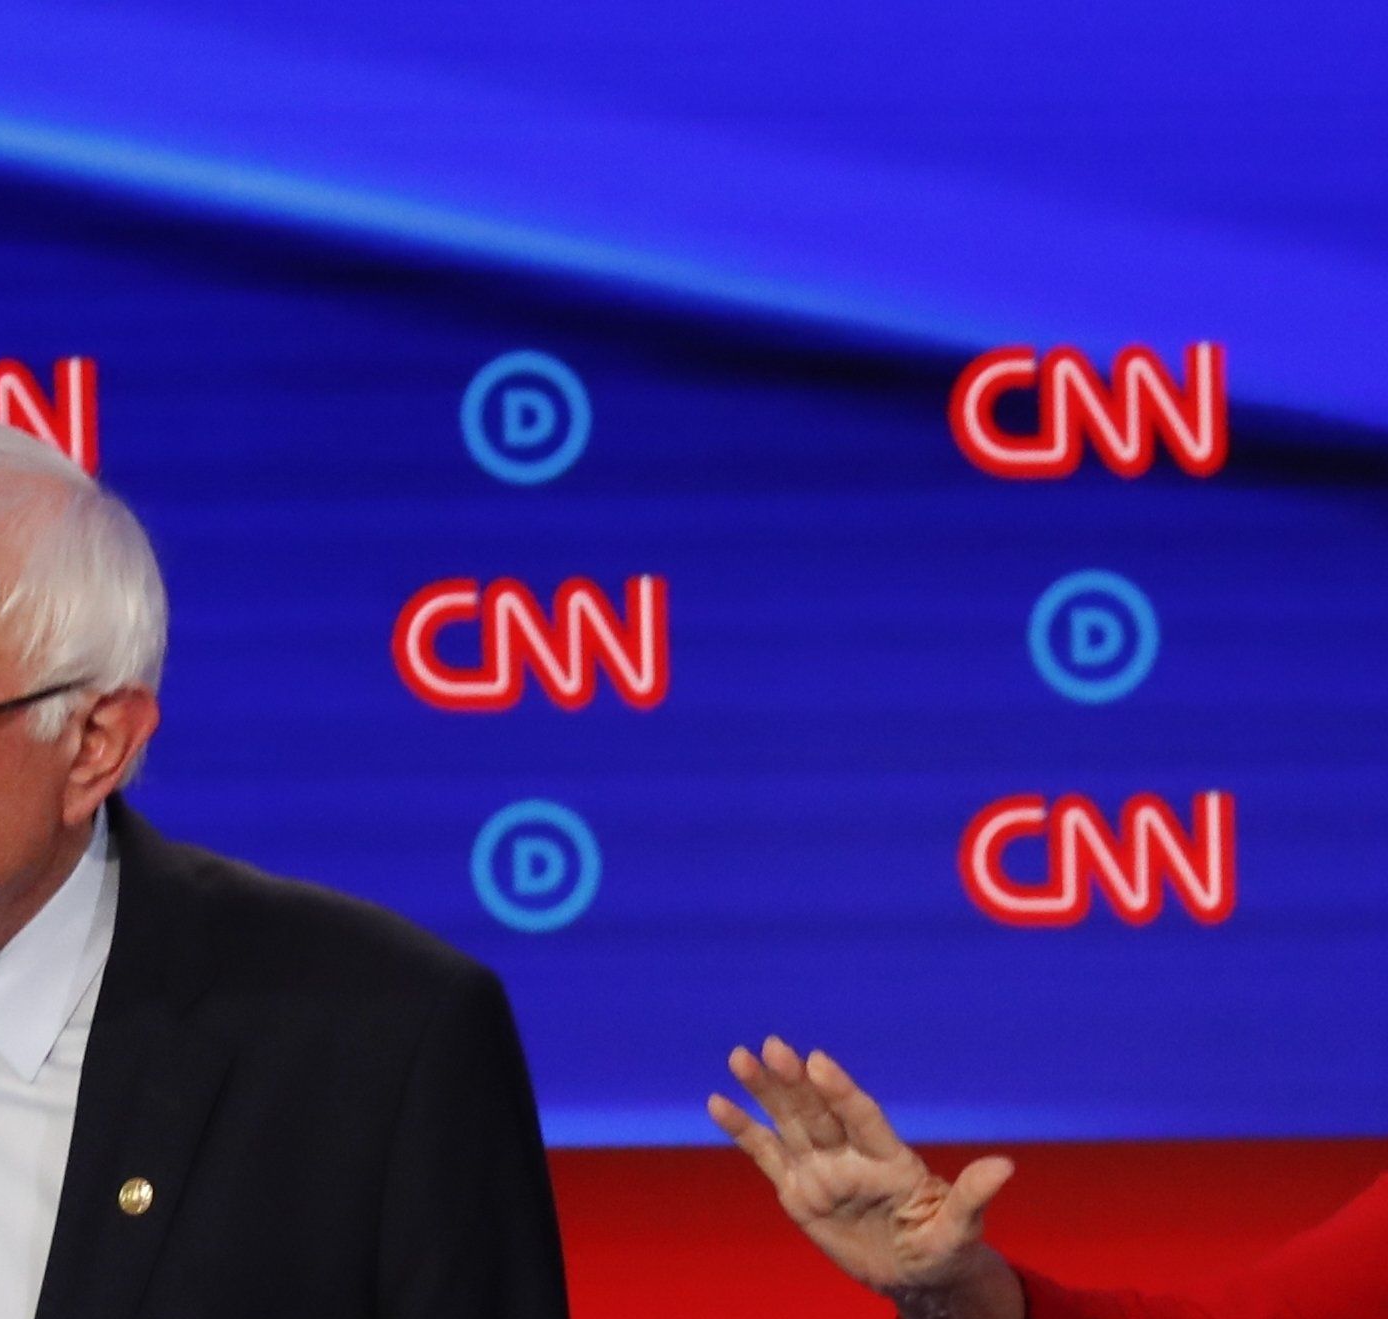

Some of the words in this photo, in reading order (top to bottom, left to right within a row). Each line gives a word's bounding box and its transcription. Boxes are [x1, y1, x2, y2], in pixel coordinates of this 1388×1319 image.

[949, 340, 1227, 479] CNN
[391, 576, 670, 712] CNN
[957, 791, 1237, 928] CNN
